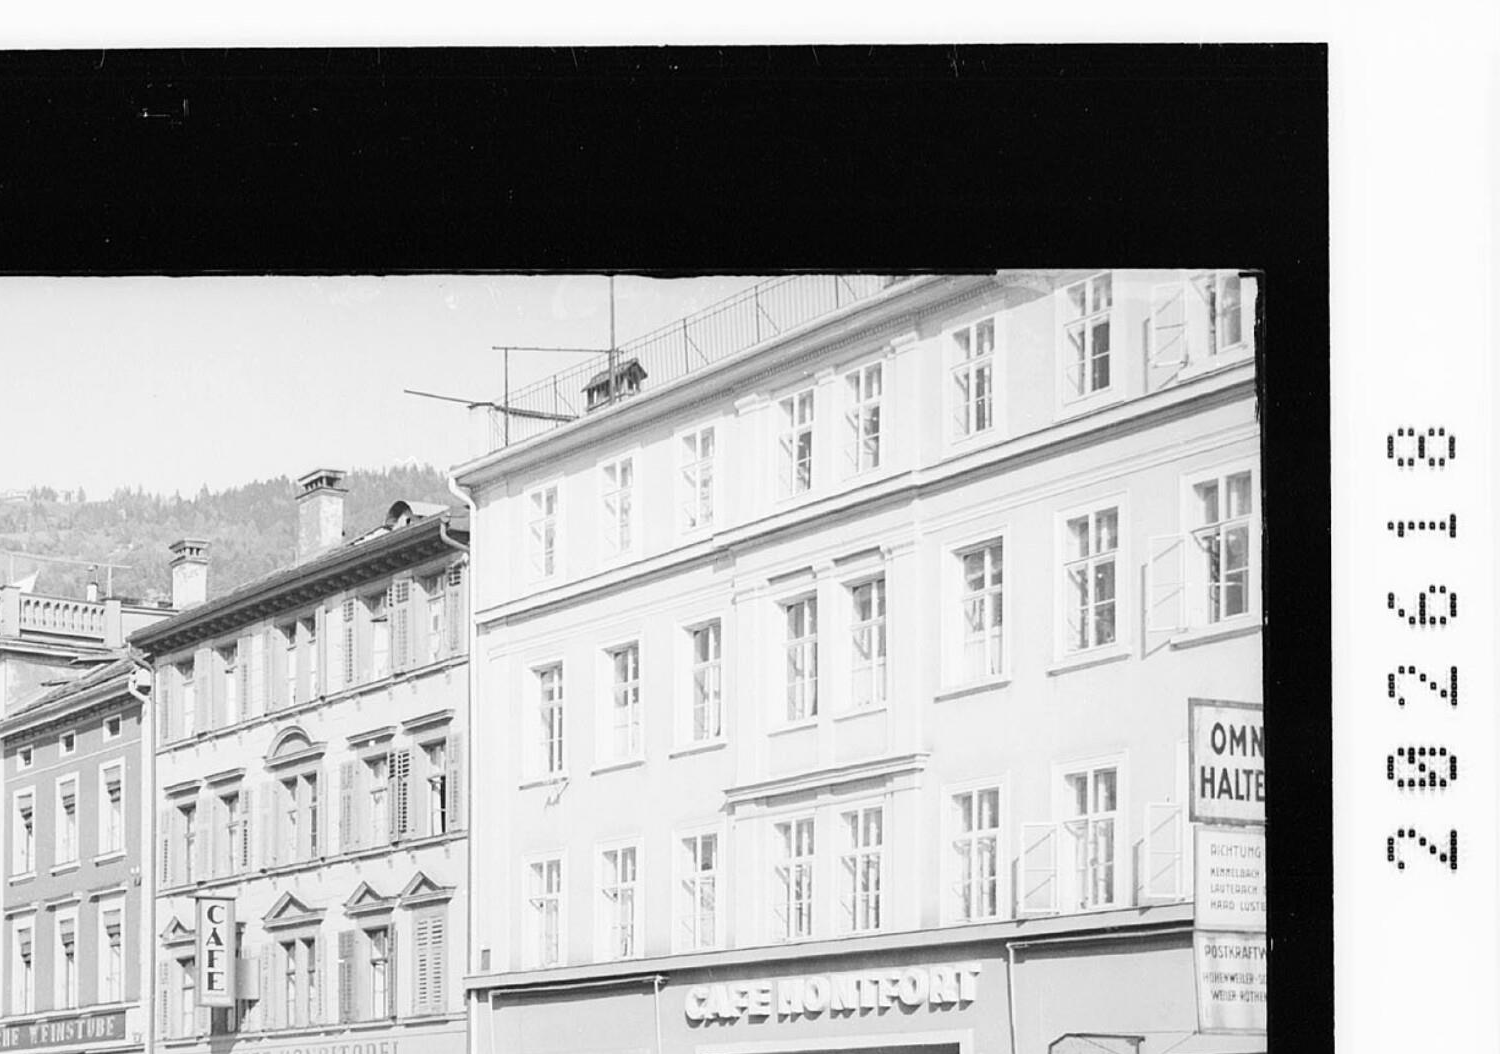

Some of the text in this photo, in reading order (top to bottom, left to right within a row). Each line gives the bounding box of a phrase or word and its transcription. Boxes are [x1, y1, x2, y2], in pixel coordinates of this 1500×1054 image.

[1200, 766, 1265, 801] HALTE
[1210, 843, 1261, 858] RICHTUNG
[206, 904, 225, 991] CAFE
[776, 962, 982, 1022] MONTFORT
[28, 1015, 117, 1044] WEINSTUBE
